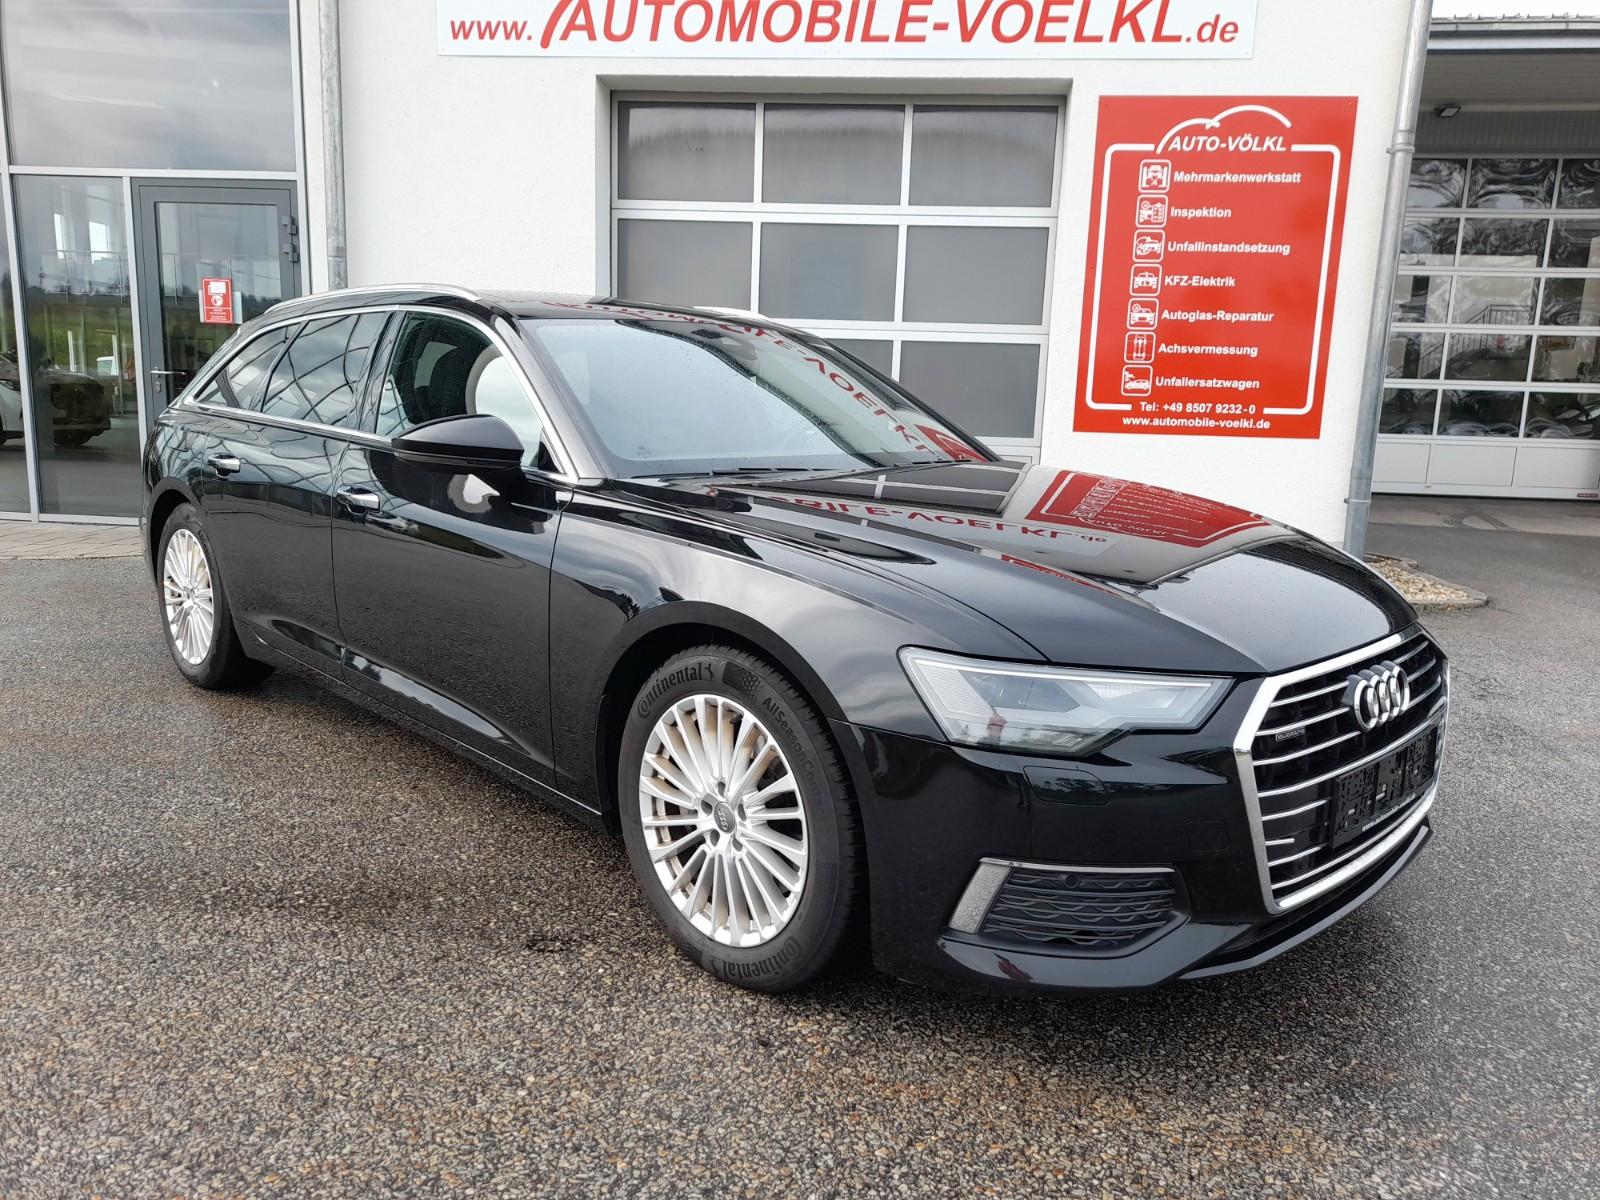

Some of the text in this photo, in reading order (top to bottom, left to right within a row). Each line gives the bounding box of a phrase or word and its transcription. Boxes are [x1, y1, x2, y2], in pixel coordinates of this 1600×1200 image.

[1168, 134, 1286, 152] AUTO-VÖLKL
[1173, 171, 1302, 184] Mehrmarkenwerkstatt
[1170, 206, 1232, 219] Inspektion
[1167, 241, 1291, 255] Unfallinstandsetzung
[1164, 275, 1236, 287] KFZ-Elektrik
[1161, 310, 1274, 323] Autoglas-Reparatur
[1158, 343, 1259, 357] Achsvermessung
[1155, 377, 1260, 390] Unfallersatzwagen
[1140, 402, 1159, 412] Tel:
[1163, 403, 1183, 413] +49
[1186, 403, 1213, 414] 8507
[1122, 417, 1271, 430] www.automobile-voelkl.de
[637, 662, 703, 719] Continental
[722, 936, 801, 978] Continental
